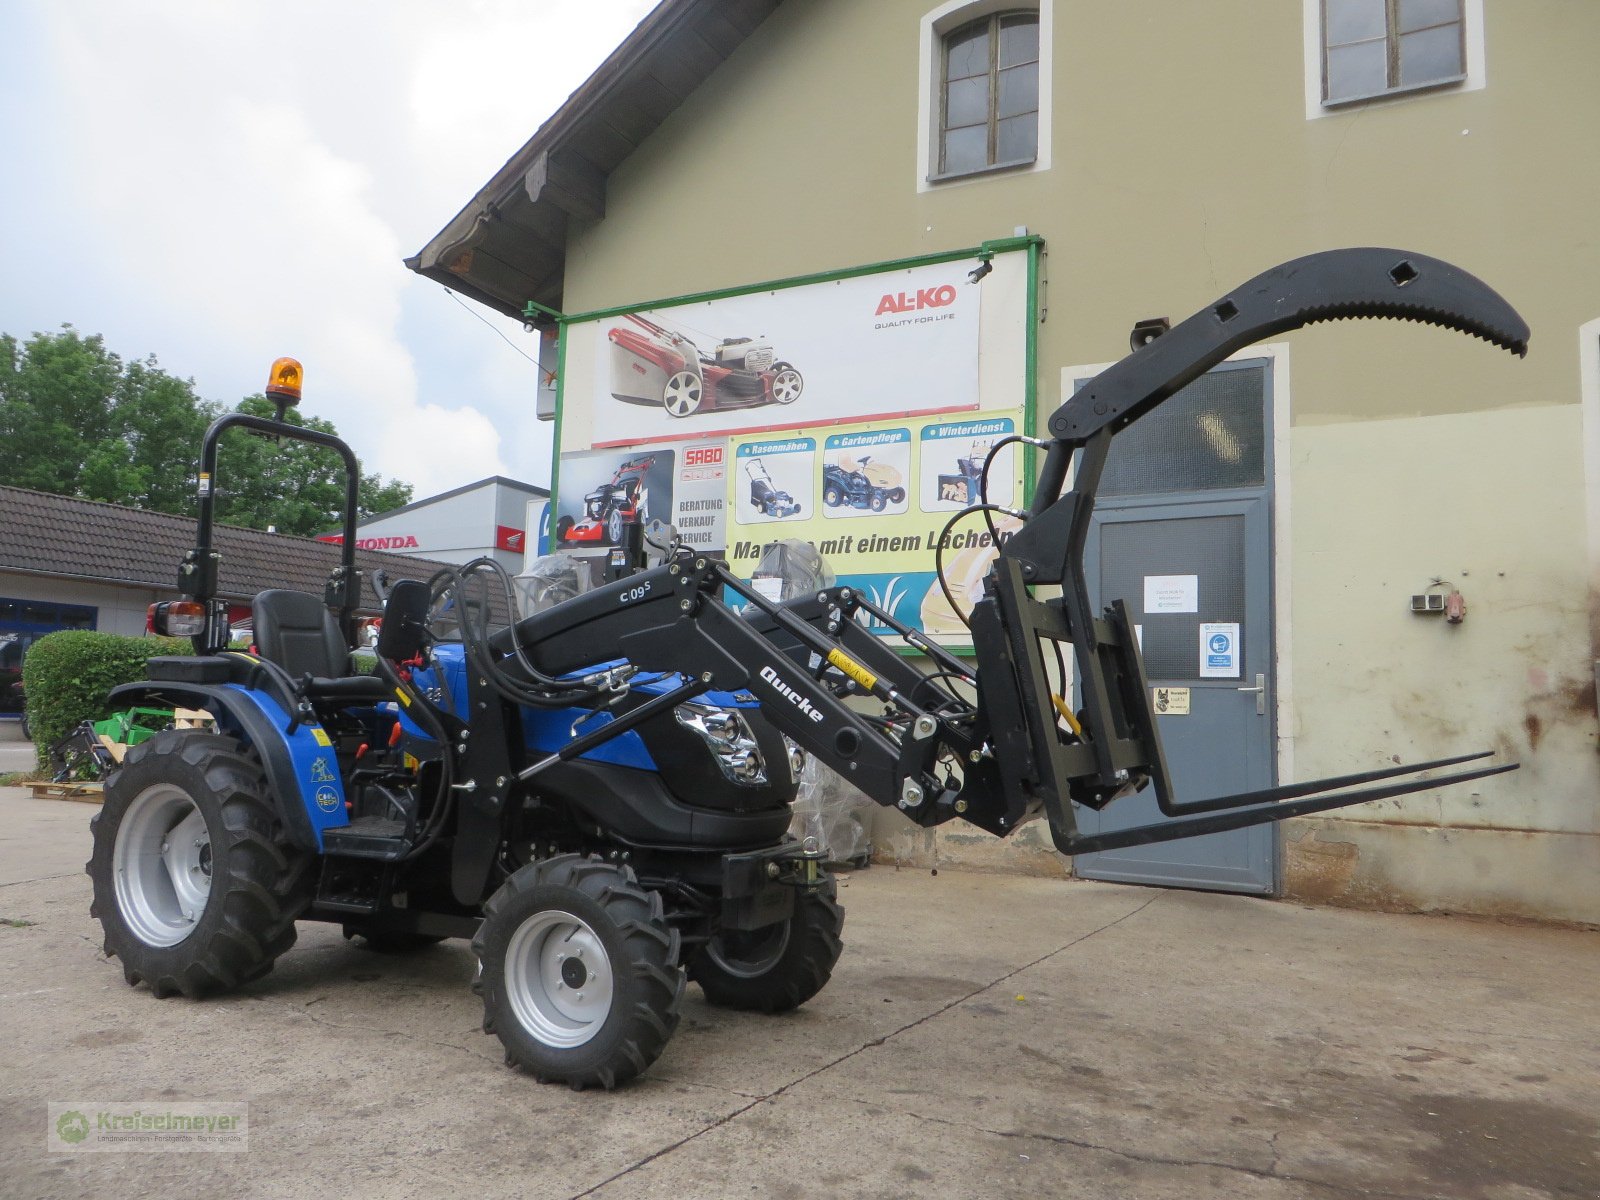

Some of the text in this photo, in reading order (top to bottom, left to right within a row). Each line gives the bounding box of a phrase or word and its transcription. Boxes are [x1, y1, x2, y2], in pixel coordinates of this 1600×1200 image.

[875, 285, 956, 315] AL-KO
[875, 313, 955, 329] QUALITY FOR LIFE
[939, 422, 1004, 437] Winterdienst
[841, 432, 902, 447] Gartenpflege
[686, 447, 723, 465] SABO
[752, 442, 808, 455] Rasenmähen
[680, 499, 722, 512] BERATUNG
[679, 515, 716, 528] VERKAUF
[679, 531, 713, 544] SERVICE
[820, 535, 854, 554] mit
[857, 531, 921, 553] einem
[760, 665, 825, 723] Quicke
